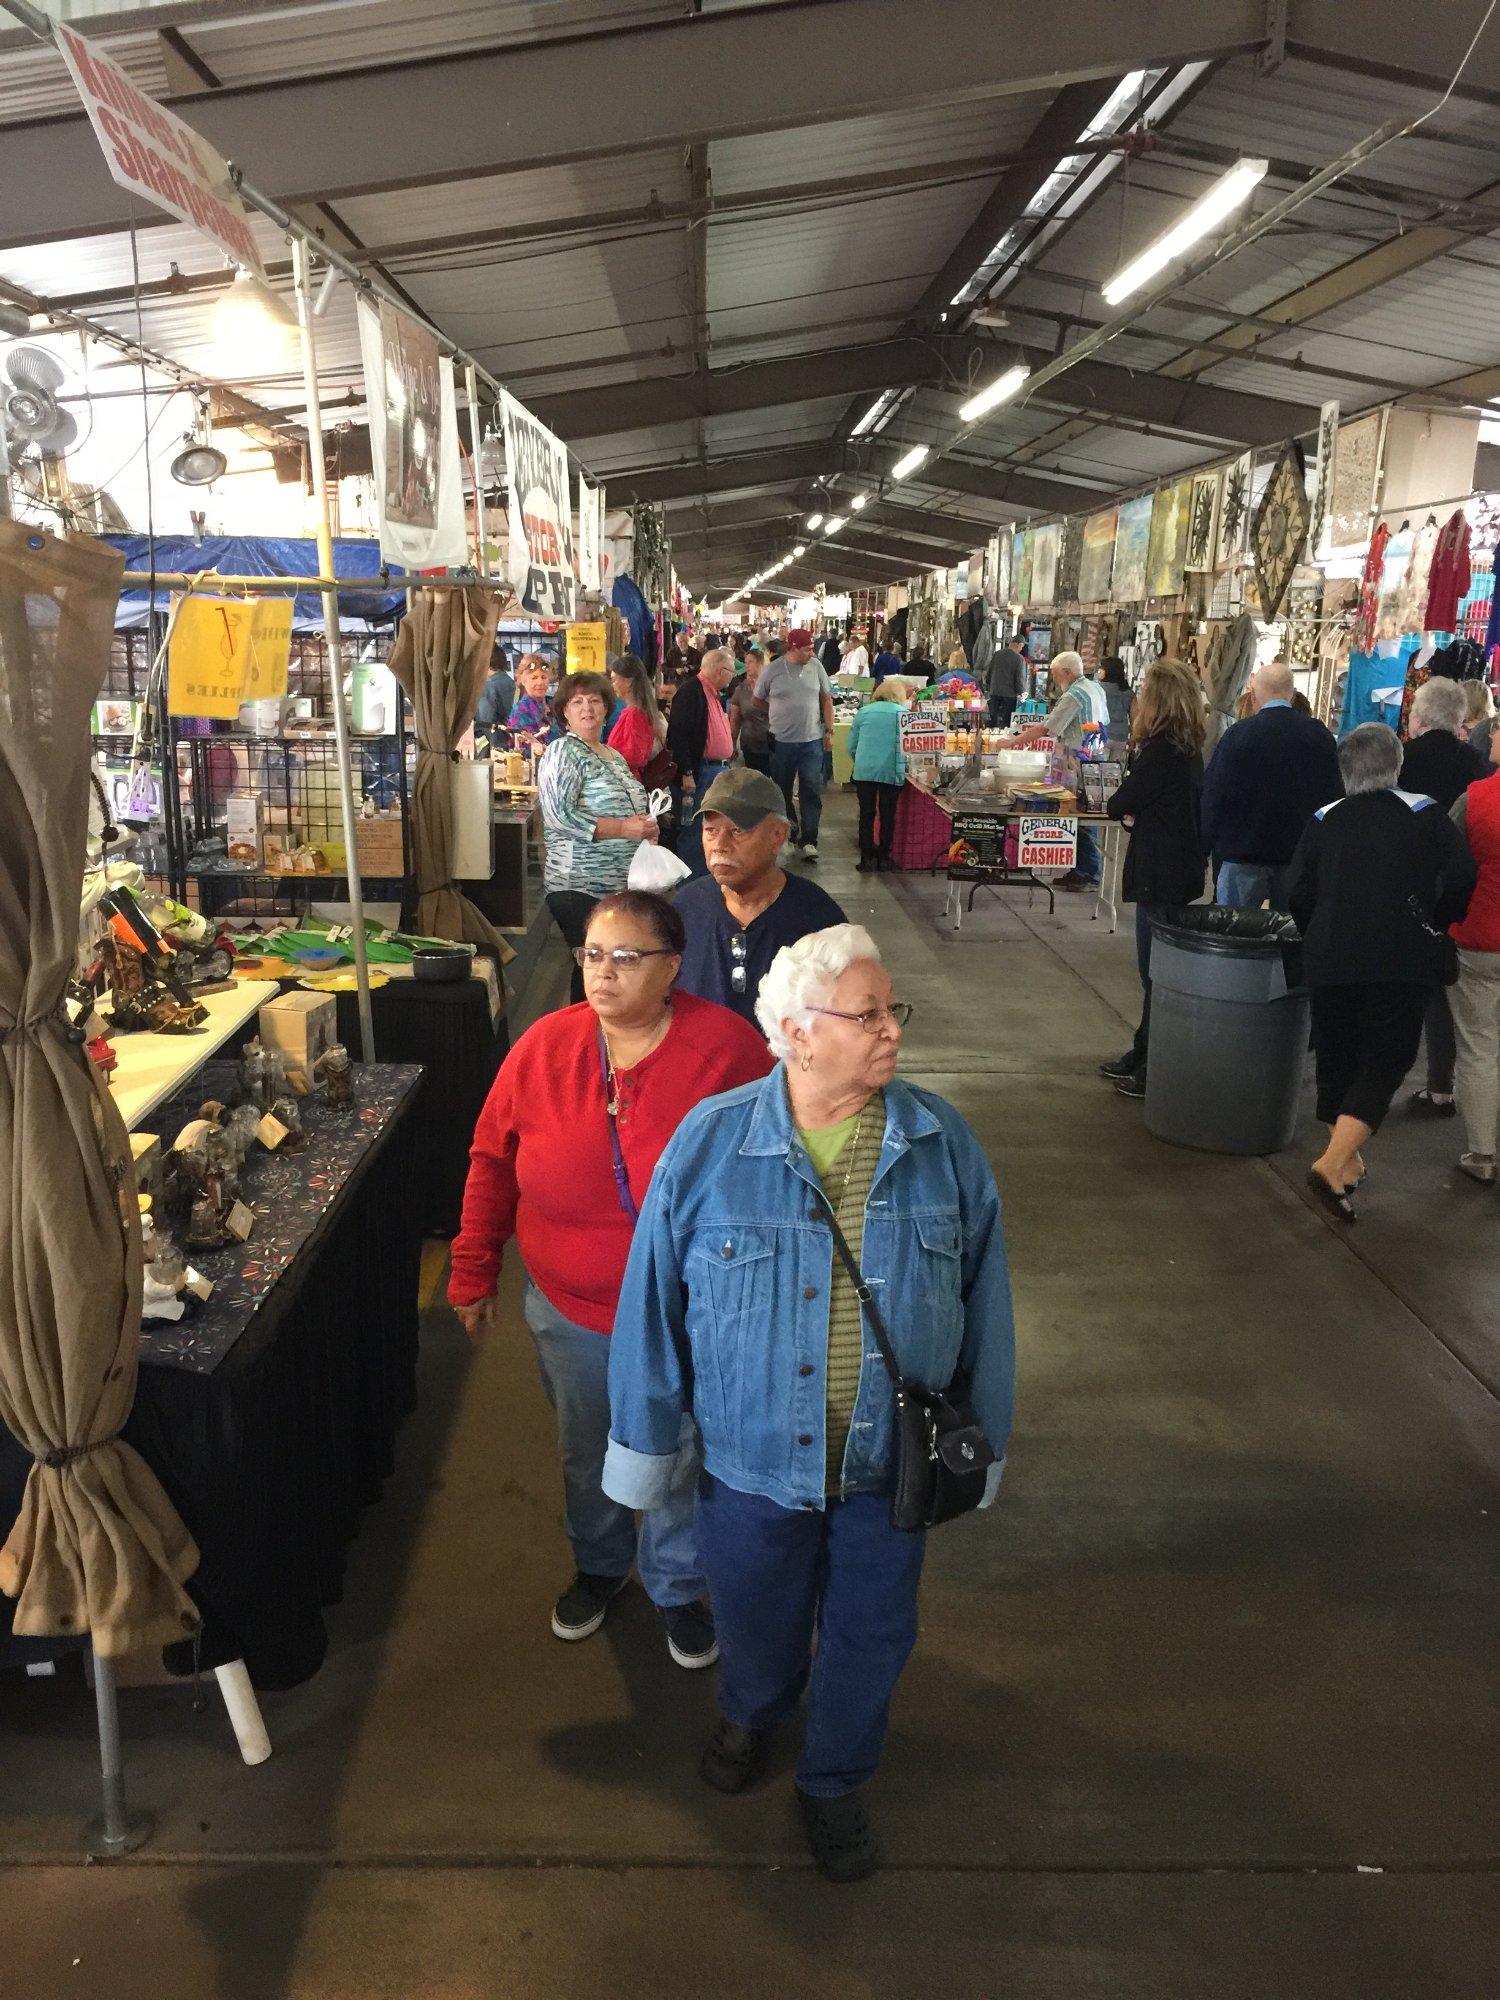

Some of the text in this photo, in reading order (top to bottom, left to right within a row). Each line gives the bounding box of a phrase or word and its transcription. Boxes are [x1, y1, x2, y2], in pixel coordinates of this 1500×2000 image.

[901, 711, 946, 728] GENERAL
[902, 736, 946, 752] CASHIER
[1021, 818, 1076, 837] GENERAL
[1021, 847, 1074, 866] CASHIER
